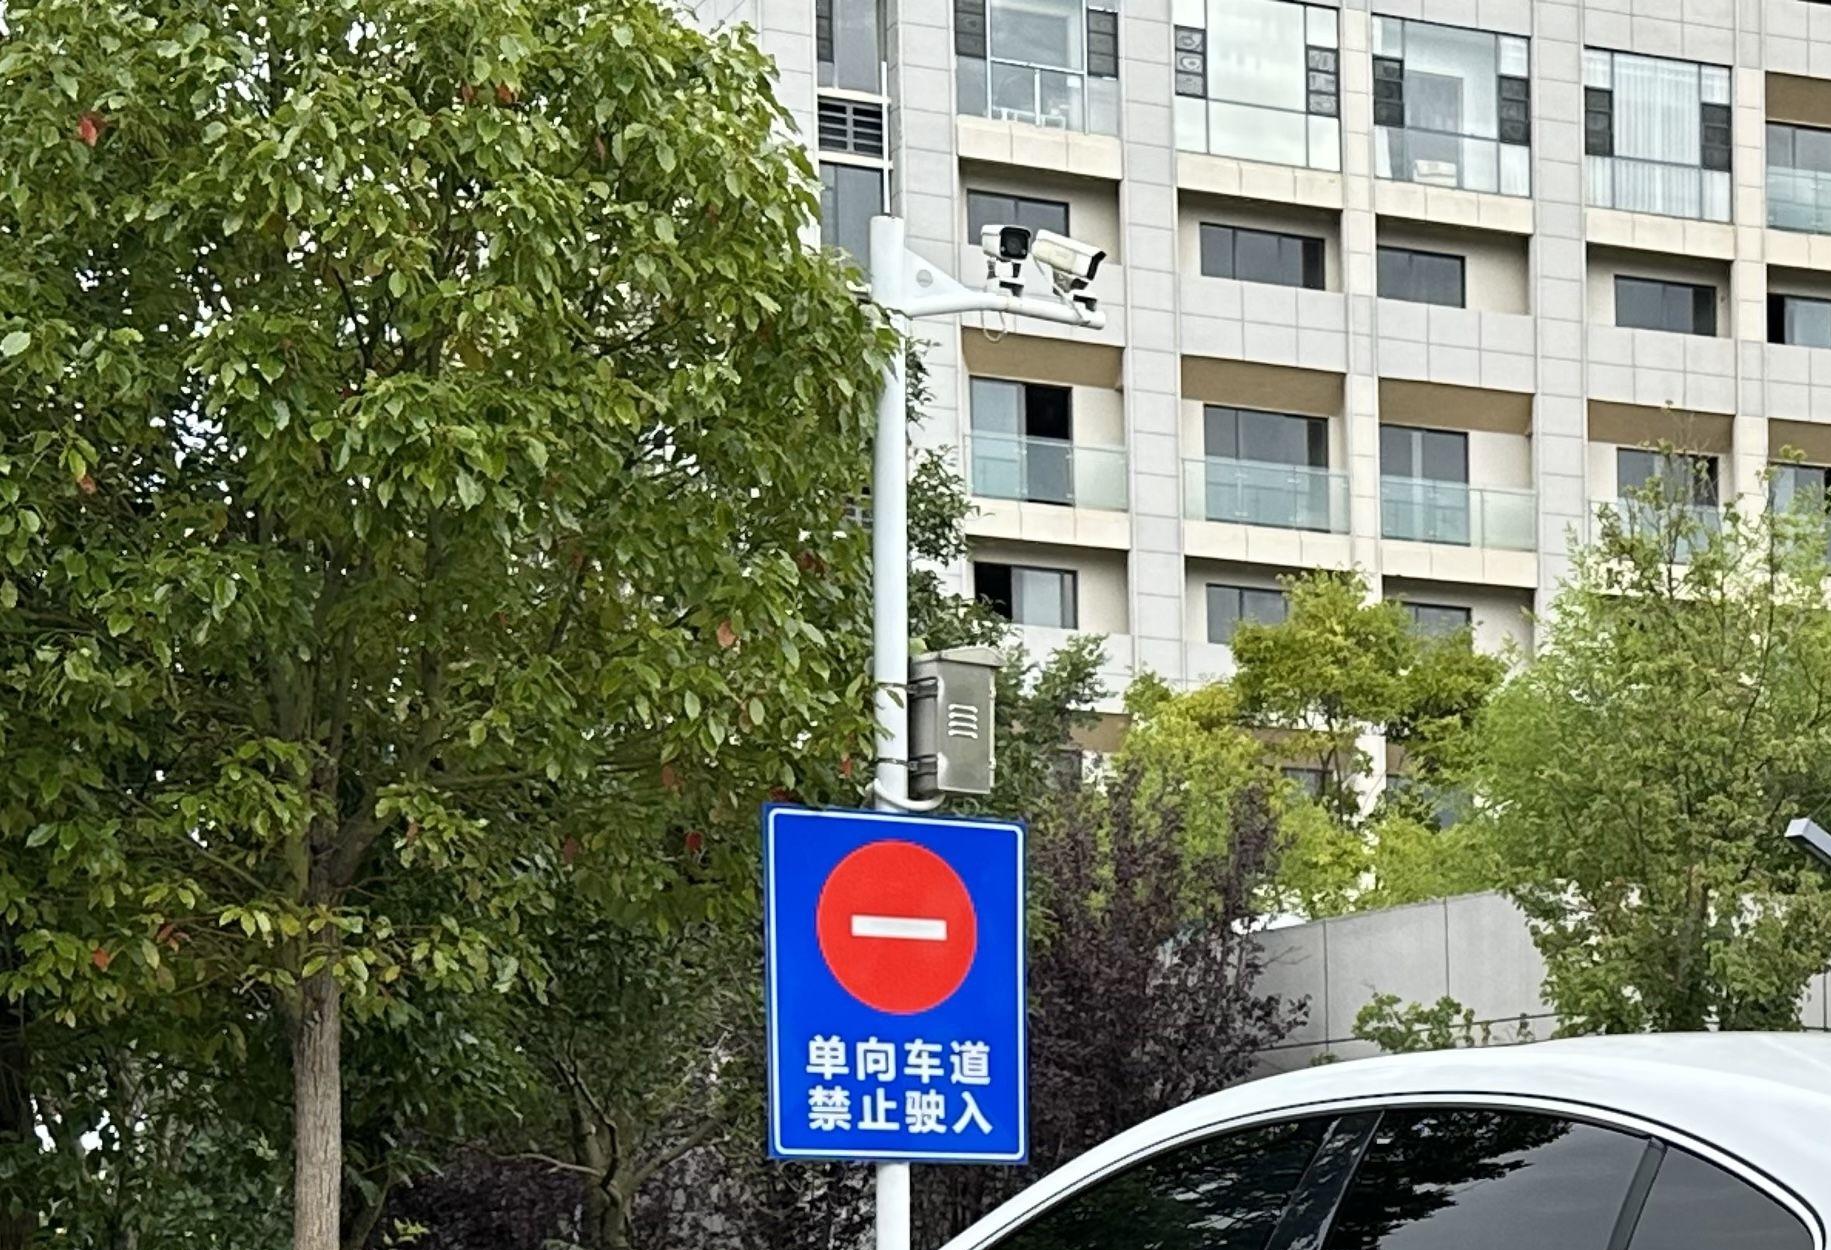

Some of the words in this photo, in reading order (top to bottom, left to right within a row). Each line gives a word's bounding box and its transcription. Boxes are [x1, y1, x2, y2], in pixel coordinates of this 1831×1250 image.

[806, 1034, 991, 1085] 单向车道
[807, 1086, 993, 1134] 禁止驶入
